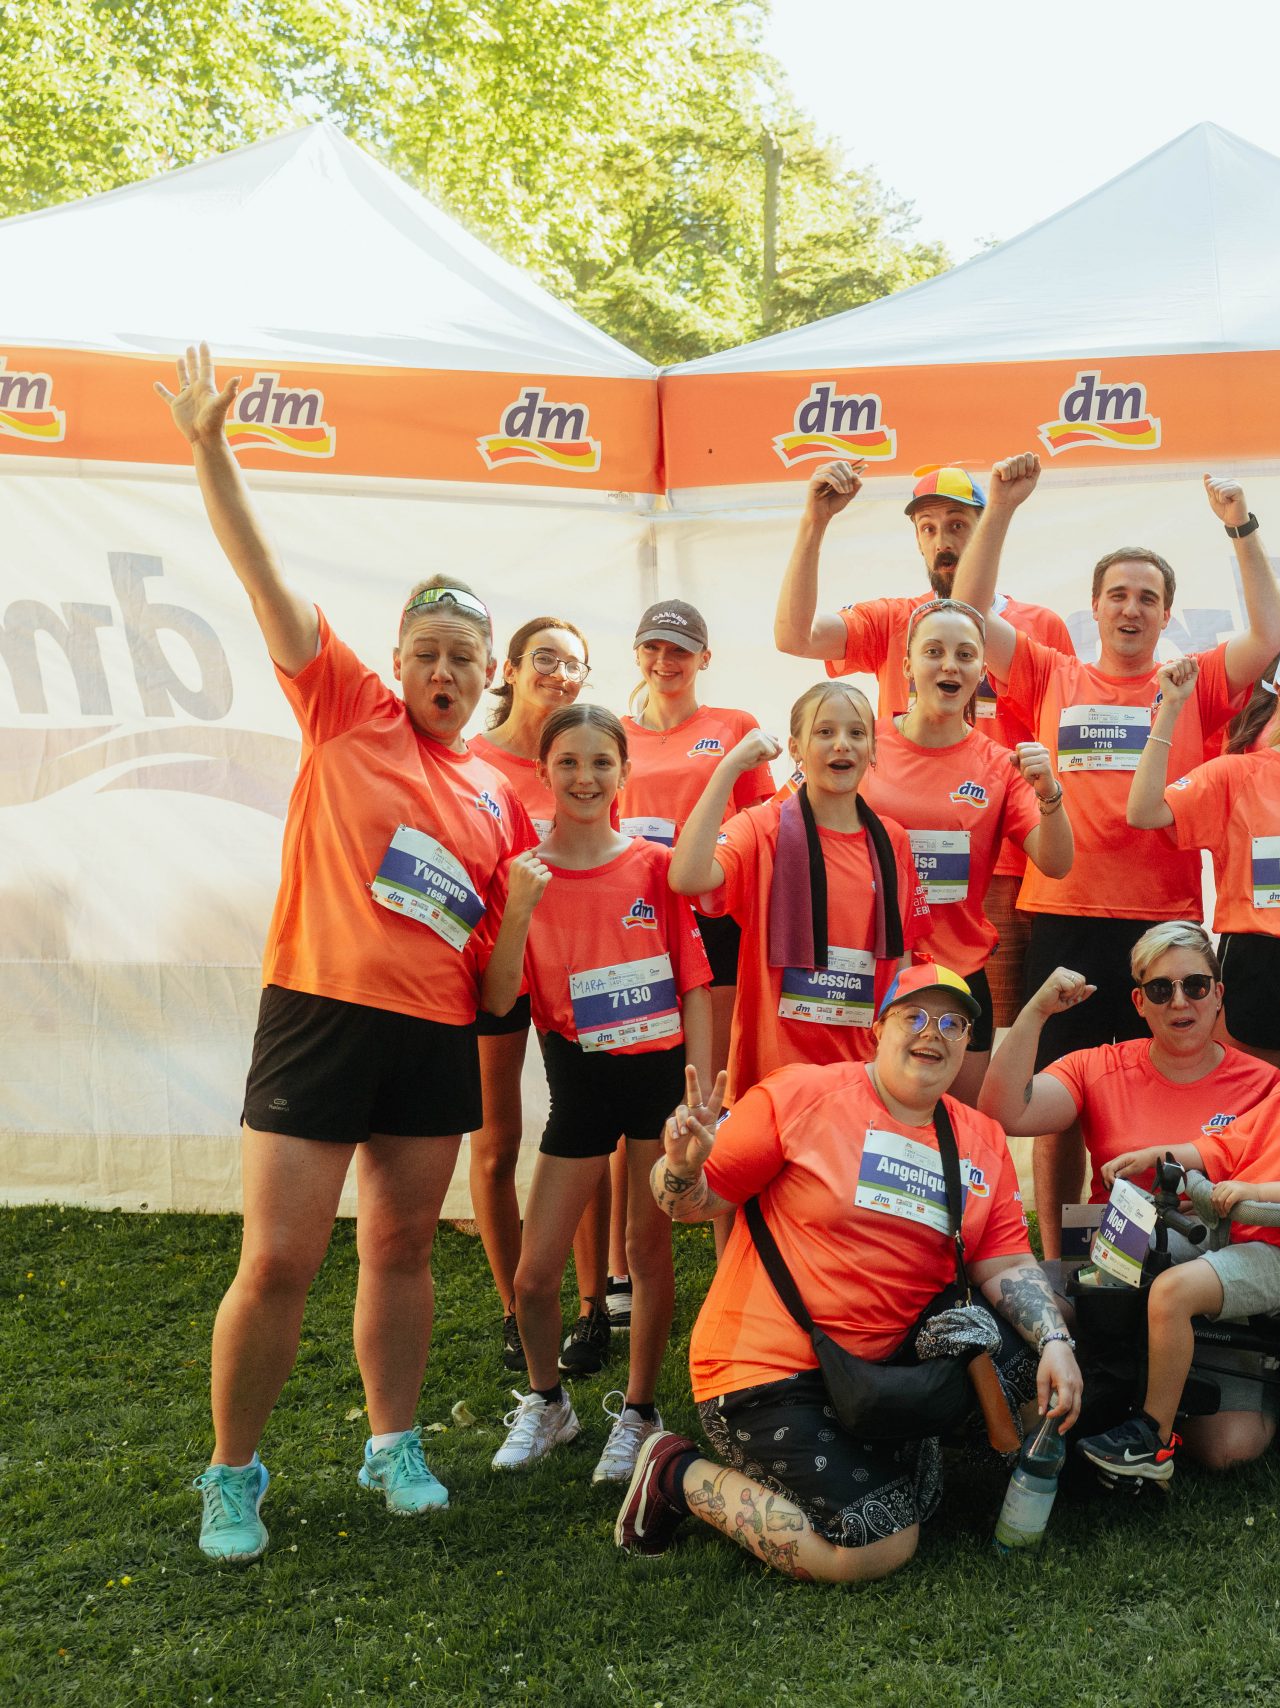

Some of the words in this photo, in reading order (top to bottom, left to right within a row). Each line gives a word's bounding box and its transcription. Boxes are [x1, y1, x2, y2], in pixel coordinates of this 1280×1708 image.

[0, 373, 47, 410] m
[1063, 375, 1143, 423] dm
[239, 376, 320, 427] dm
[505, 392, 584, 440] dm
[799, 386, 878, 434] dm
[1080, 725, 1127, 739] Dennis
[694, 739, 719, 751] dm
[1093, 741, 1113, 749] 1716
[1070, 756, 1083, 764] dm
[958, 782, 985, 799] dm
[912, 853, 937, 869] isa
[413, 858, 468, 903] Yvonne
[917, 872, 929, 880] 87
[387, 891, 405, 904] dm
[426, 887, 447, 905] 1698
[572, 978, 607, 996] MARA
[808, 971, 862, 990] Jessica
[608, 985, 652, 1009] 7130
[827, 990, 846, 1000] 1704
[795, 1004, 811, 1013] dm
[597, 1032, 613, 1043] dm
[877, 1156, 946, 1193] Angeliqu
[874, 1193, 890, 1204] dm
[905, 1184, 926, 1198] 1711
[1106, 1207, 1128, 1234] Noel
[1103, 1228, 1116, 1244] 1714
